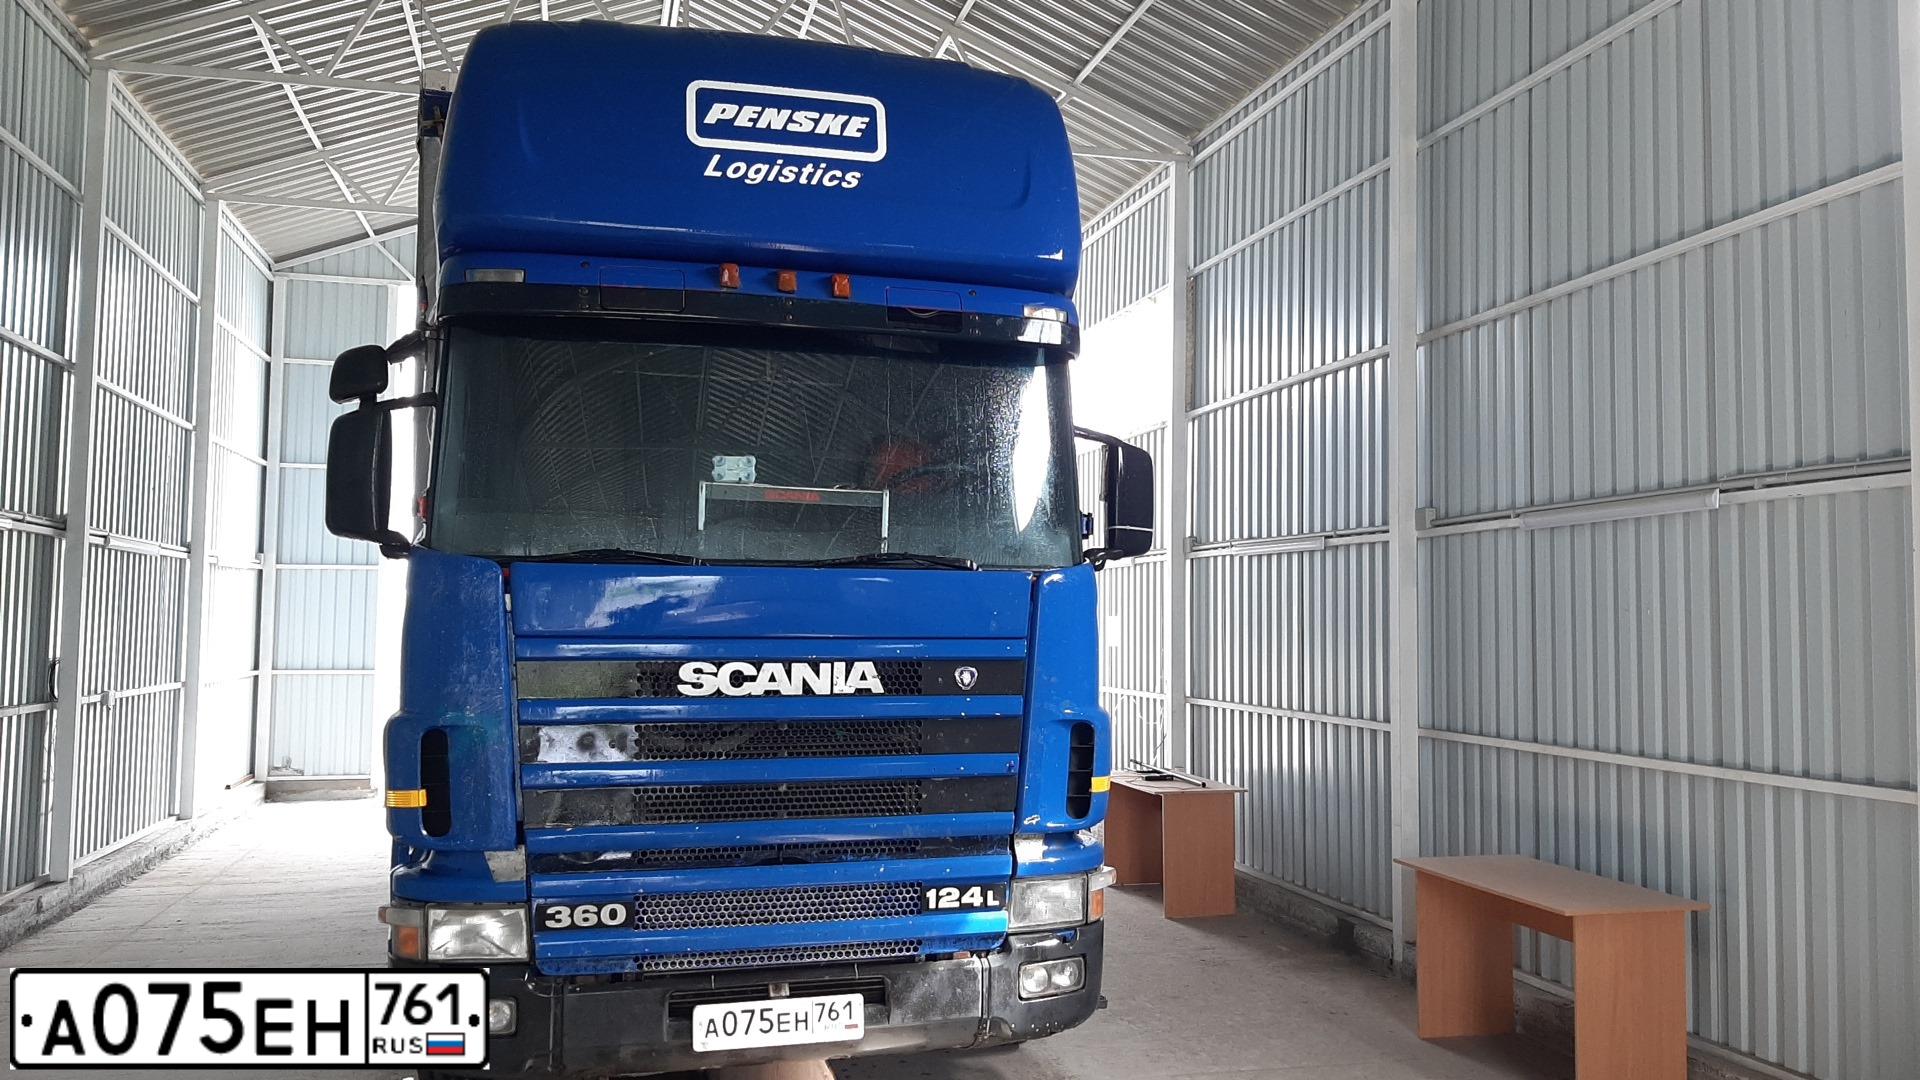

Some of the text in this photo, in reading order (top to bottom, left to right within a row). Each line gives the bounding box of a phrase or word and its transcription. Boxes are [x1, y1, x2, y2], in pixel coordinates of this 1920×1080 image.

[703, 103, 870, 138] PENSKE
[703, 154, 862, 189] Logistics
[676, 661, 885, 696] SCANIA
[545, 903, 627, 928] 360
[814, 1000, 852, 1023] 761
